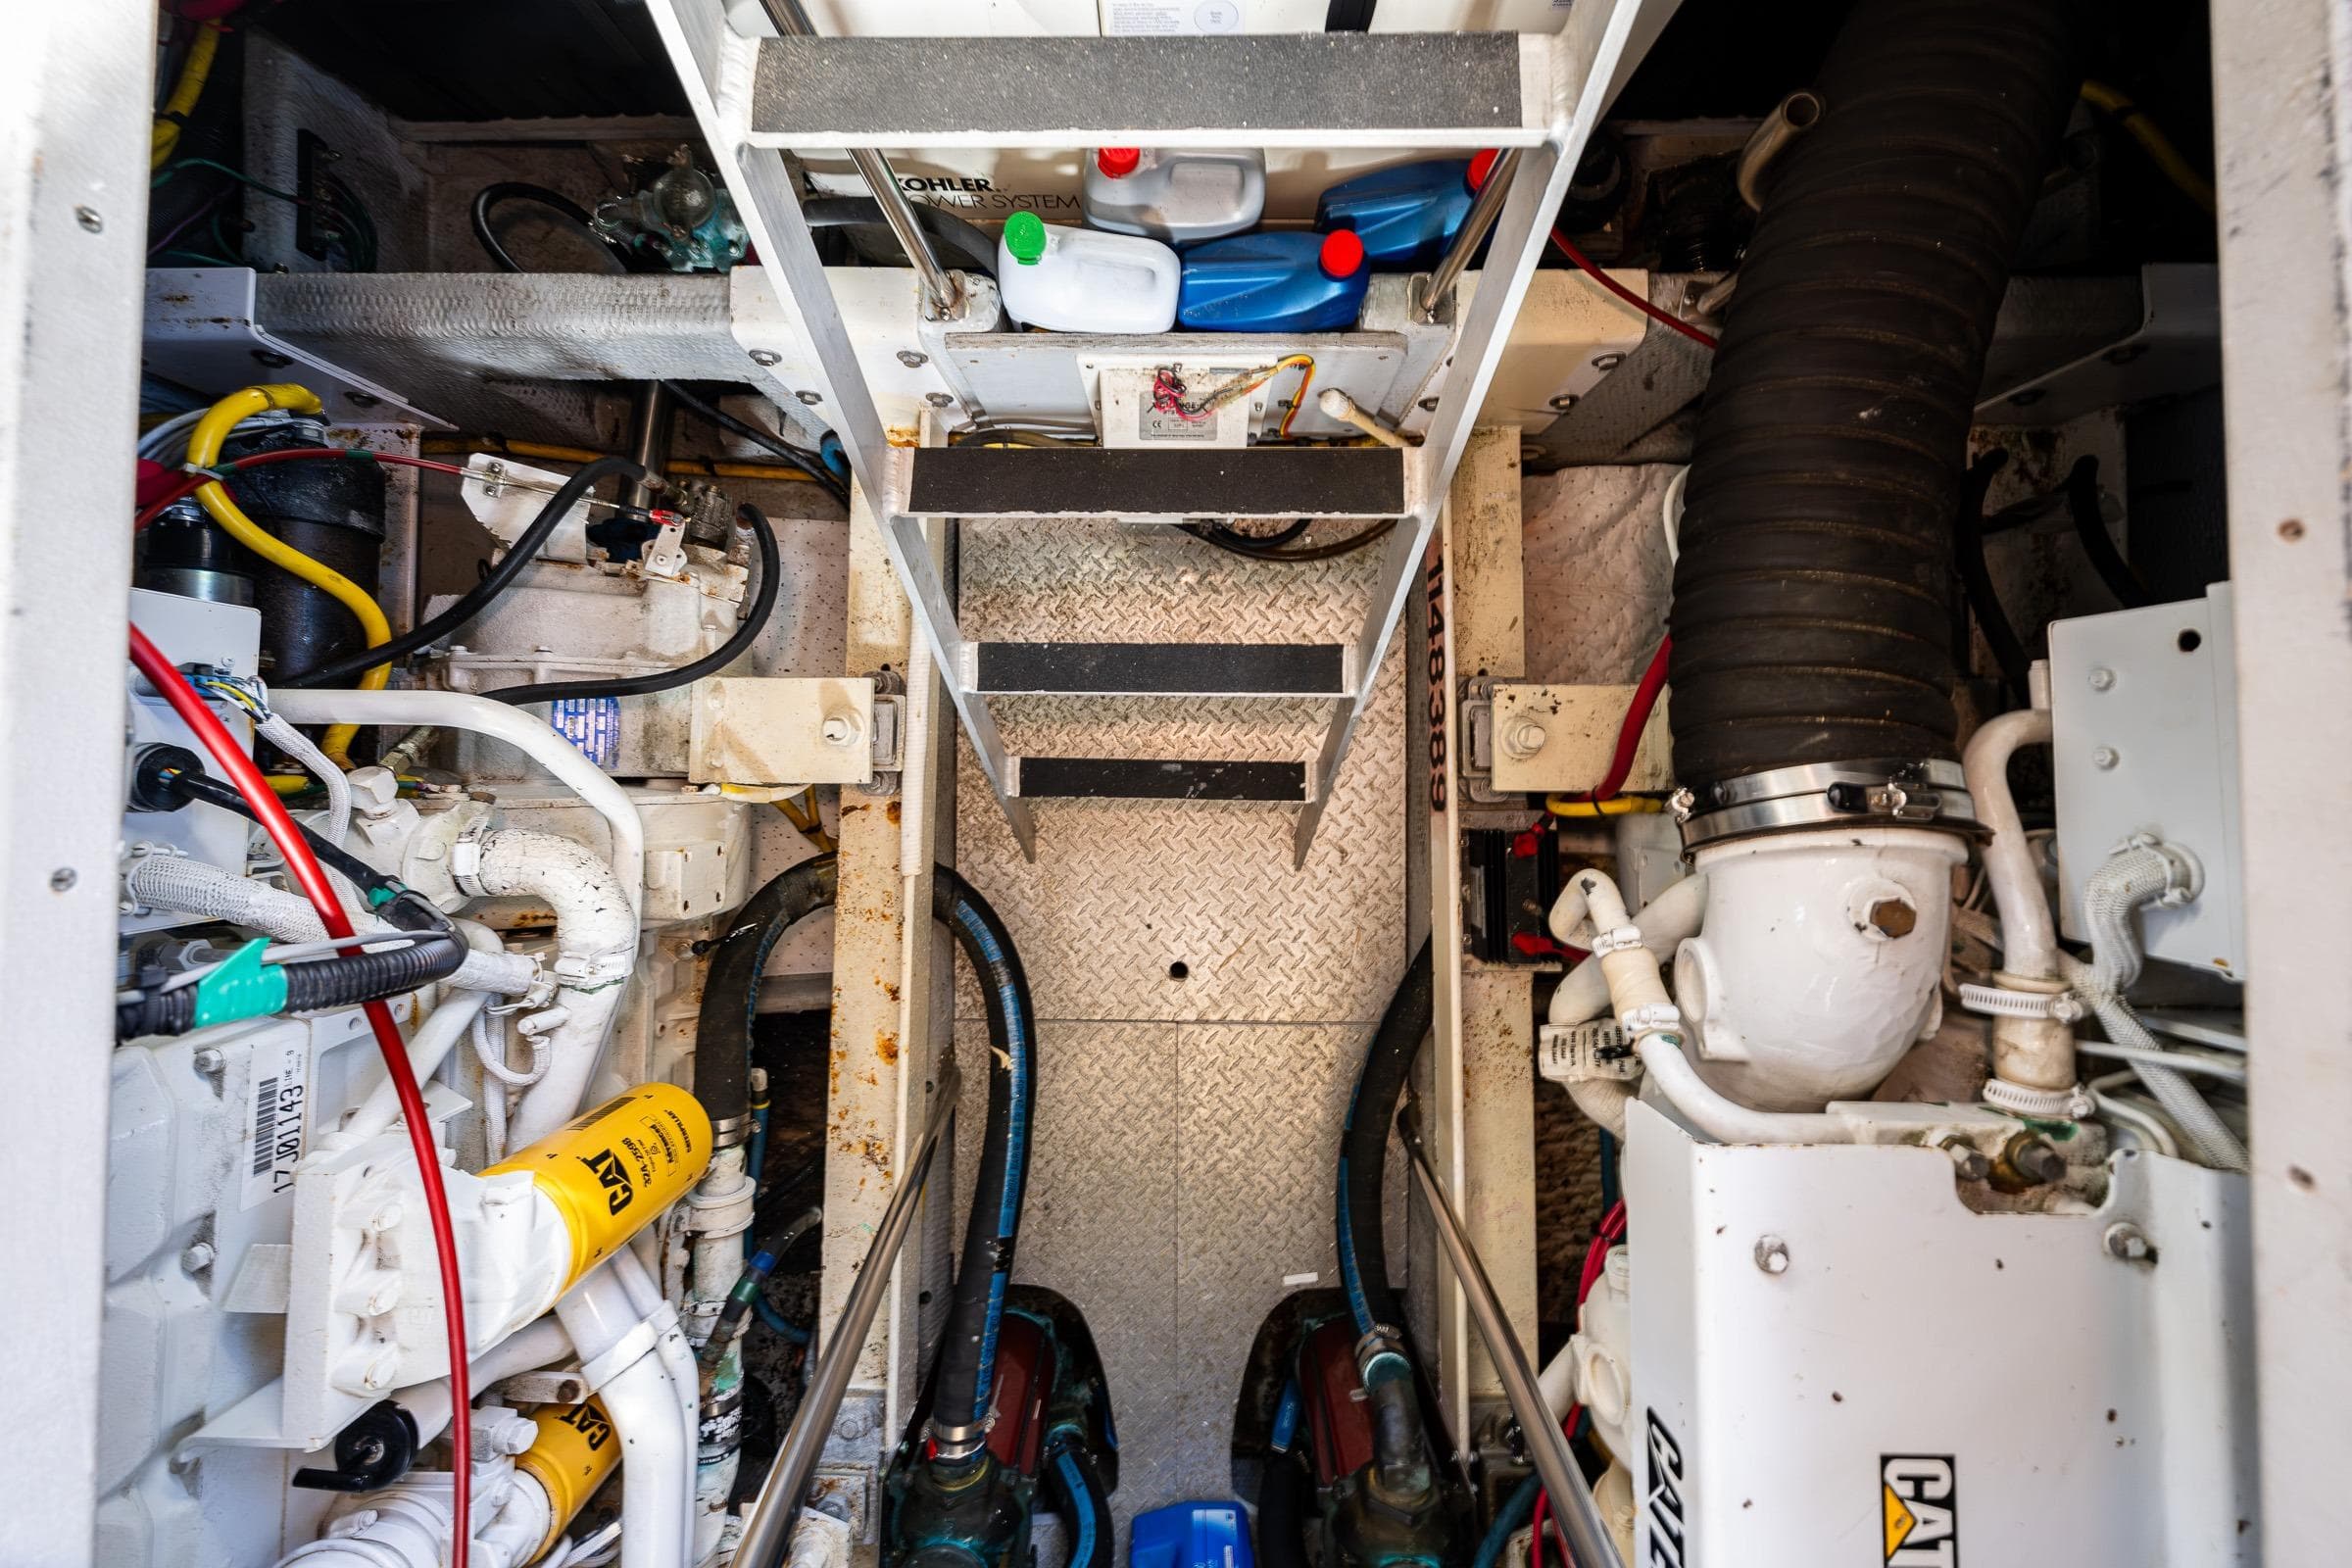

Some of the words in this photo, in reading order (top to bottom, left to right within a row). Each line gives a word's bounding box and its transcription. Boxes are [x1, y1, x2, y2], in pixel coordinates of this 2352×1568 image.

[907, 194, 989, 209] OWER
[993, 194, 1081, 210] SYSTEM
[1427, 554, 1446, 812] 1148389
[580, 1148, 633, 1216] CAT
[558, 1401, 612, 1451] CAT
[1884, 1457, 1955, 1568] CAT
